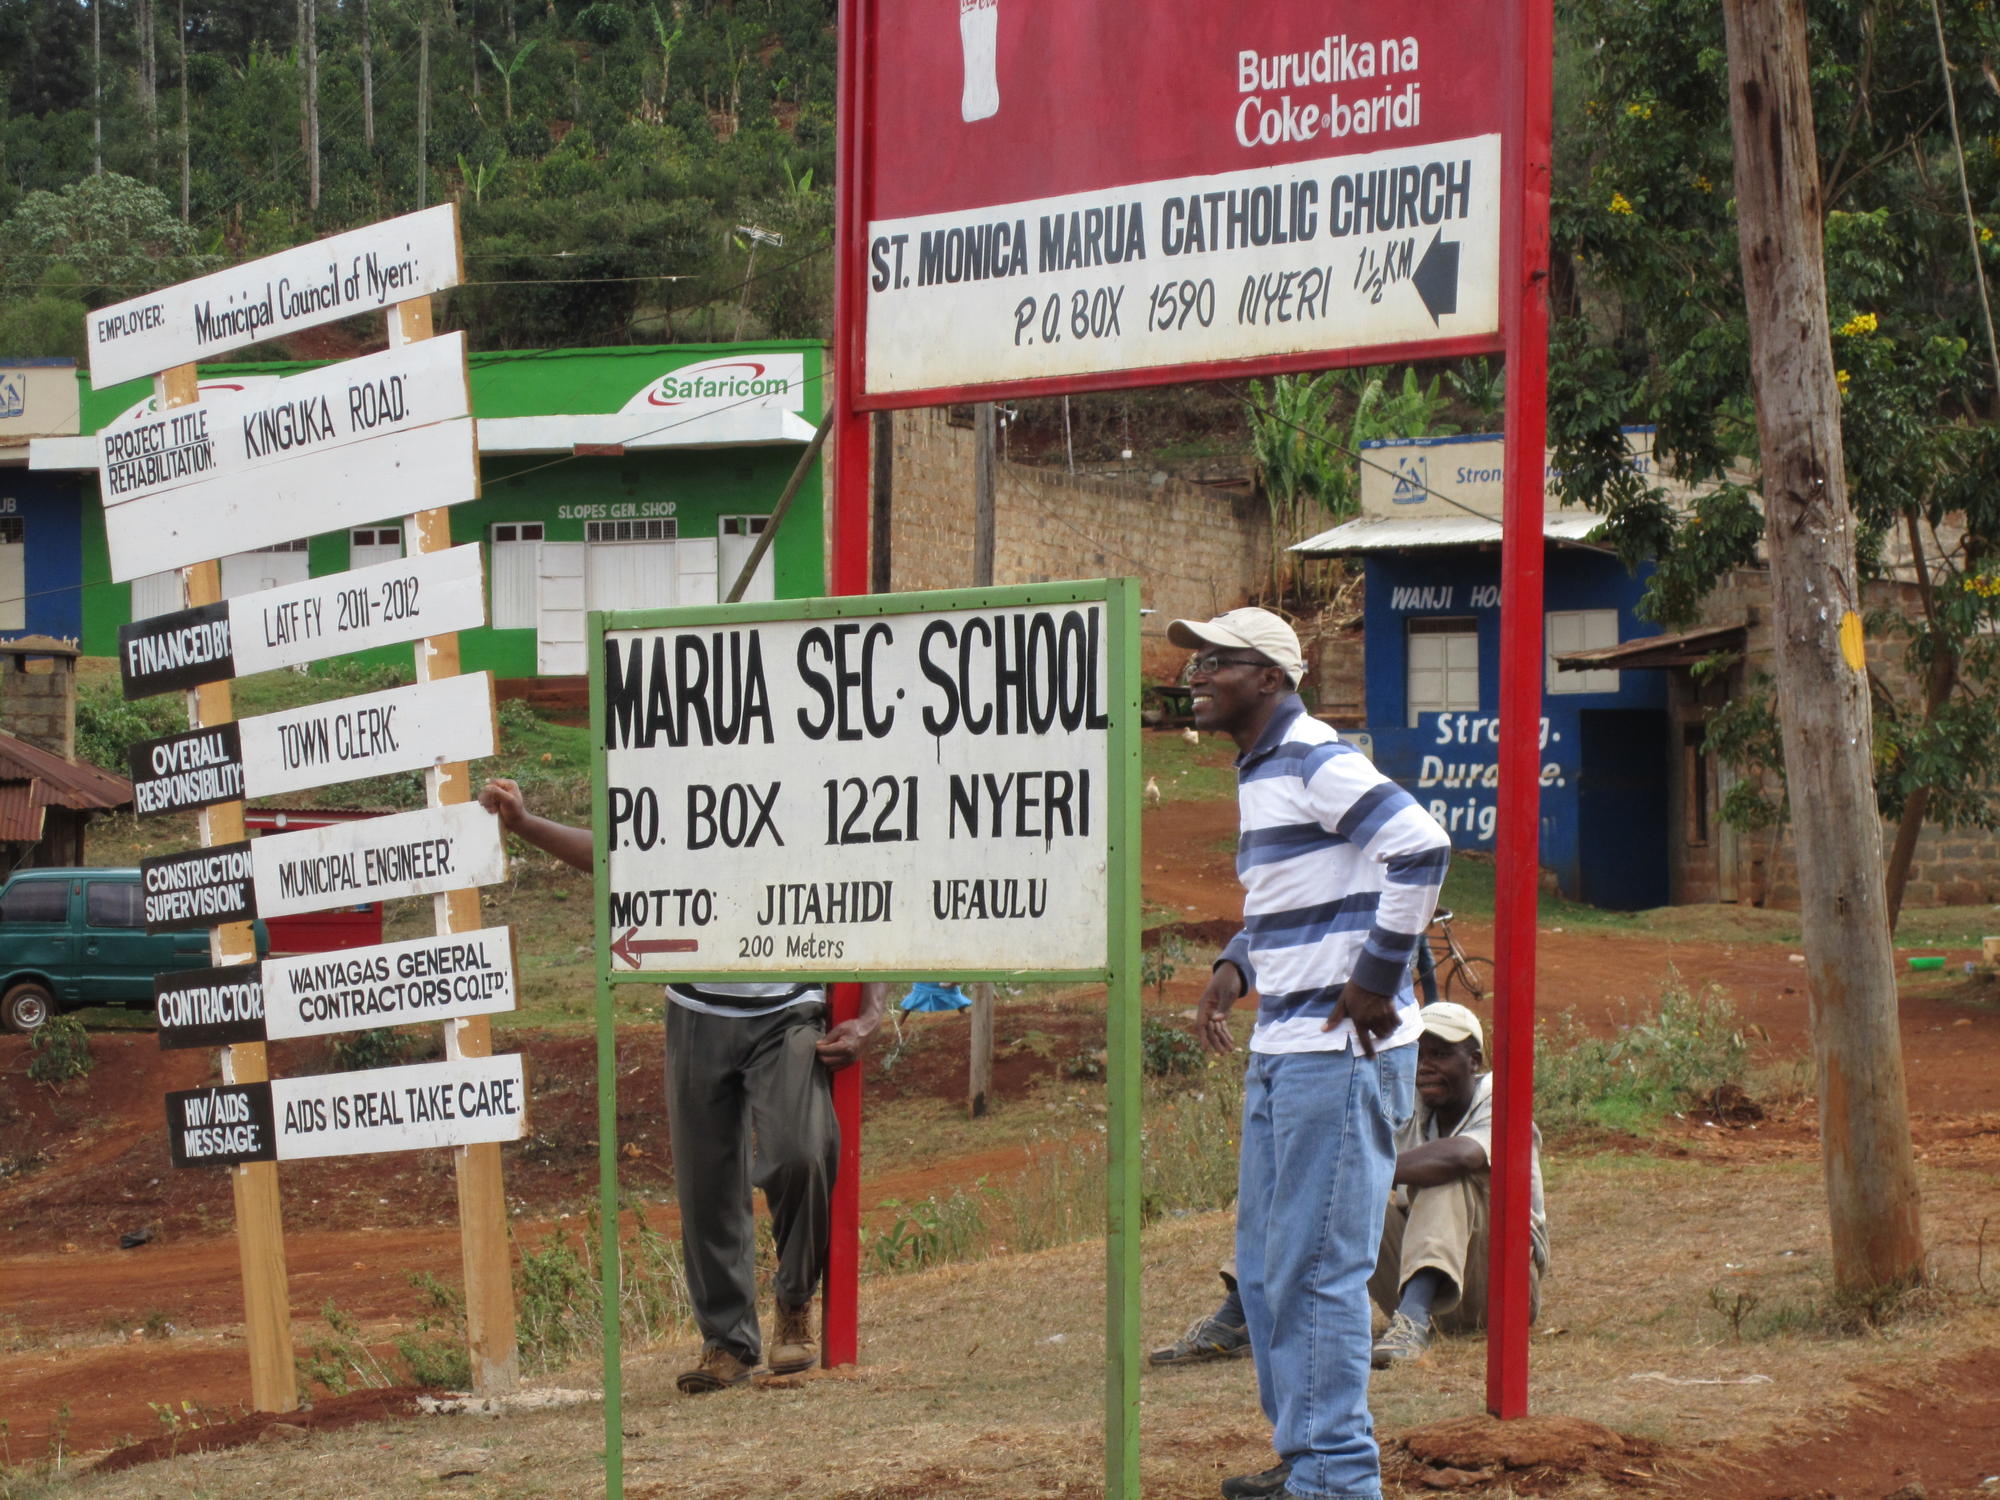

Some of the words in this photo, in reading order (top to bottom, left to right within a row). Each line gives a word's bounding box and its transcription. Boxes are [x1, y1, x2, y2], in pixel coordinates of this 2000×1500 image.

[1331, 82, 1421, 138] baridi
[871, 233, 910, 293] ST.
[917, 219, 1029, 287] MONICA
[1038, 201, 1147, 273] MARUA
[1161, 179, 1319, 256] CATHOLIC
[1329, 159, 1472, 238] CHURCH
[97, 303, 166, 344] EMPLOYER:
[194, 282, 275, 346] Municipal
[278, 263, 342, 321] Council
[344, 255, 361, 302] of
[1071, 284, 1125, 340] BOX
[1149, 278, 1216, 333] 1590
[1238, 265, 1333, 326] NYERI
[348, 373, 410, 433] ROAD:
[661, 375, 789, 401] Safaricom
[104, 421, 166, 466] PROJECT
[170, 409, 209, 446] TITLE
[107, 440, 217, 496] REHABILITATION:
[1455, 466, 1505, 485] Stron
[558, 503, 607, 519] SLOPES
[610, 502, 640, 518] GEN.
[640, 501, 677, 517] SHOP
[263, 601, 300, 648] LATF
[303, 596, 322, 639] FY
[337, 576, 420, 632] 2011-2012
[1390, 585, 1454, 611] WANJI
[127, 623, 214, 678] FINANCED
[606, 628, 775, 751] MARUA
[797, 621, 906, 742] SEC.
[919, 606, 1110, 738] SCHOOL
[151, 731, 231, 776] OVERALL
[277, 717, 331, 771] TOWN
[335, 704, 400, 762] CLERK:
[135, 761, 244, 814] RESPONSIBILITY:
[1418, 754, 1566, 789] Durae.
[687, 780, 786, 851] BOX
[823, 774, 921, 847] 1221
[948, 768, 1092, 845] NYERI
[145, 850, 254, 893] CONSTRUCTION
[278, 851, 362, 900] MUNICIPAL
[365, 837, 456, 887] ENGINEER:
[145, 882, 246, 923] SUPERVISION:
[609, 887, 719, 929] MOTTO:
[756, 879, 895, 927] JITAHIDI
[931, 877, 1049, 922] UFAULU
[288, 956, 391, 995] WANYAGAS
[396, 941, 492, 979] GENERAL
[738, 935, 775, 959] 200
[786, 932, 845, 960] Meters
[298, 977, 452, 1023] CONTRACTORS
[184, 1087, 250, 1128] HIV/AIDS
[284, 1098, 327, 1135] AIDS
[332, 1094, 351, 1129] IS
[353, 1090, 404, 1129] REAL
[405, 1083, 456, 1123] TAKE
[457, 1078, 521, 1118] CARE:
[183, 1124, 262, 1158] MESSAGE:
